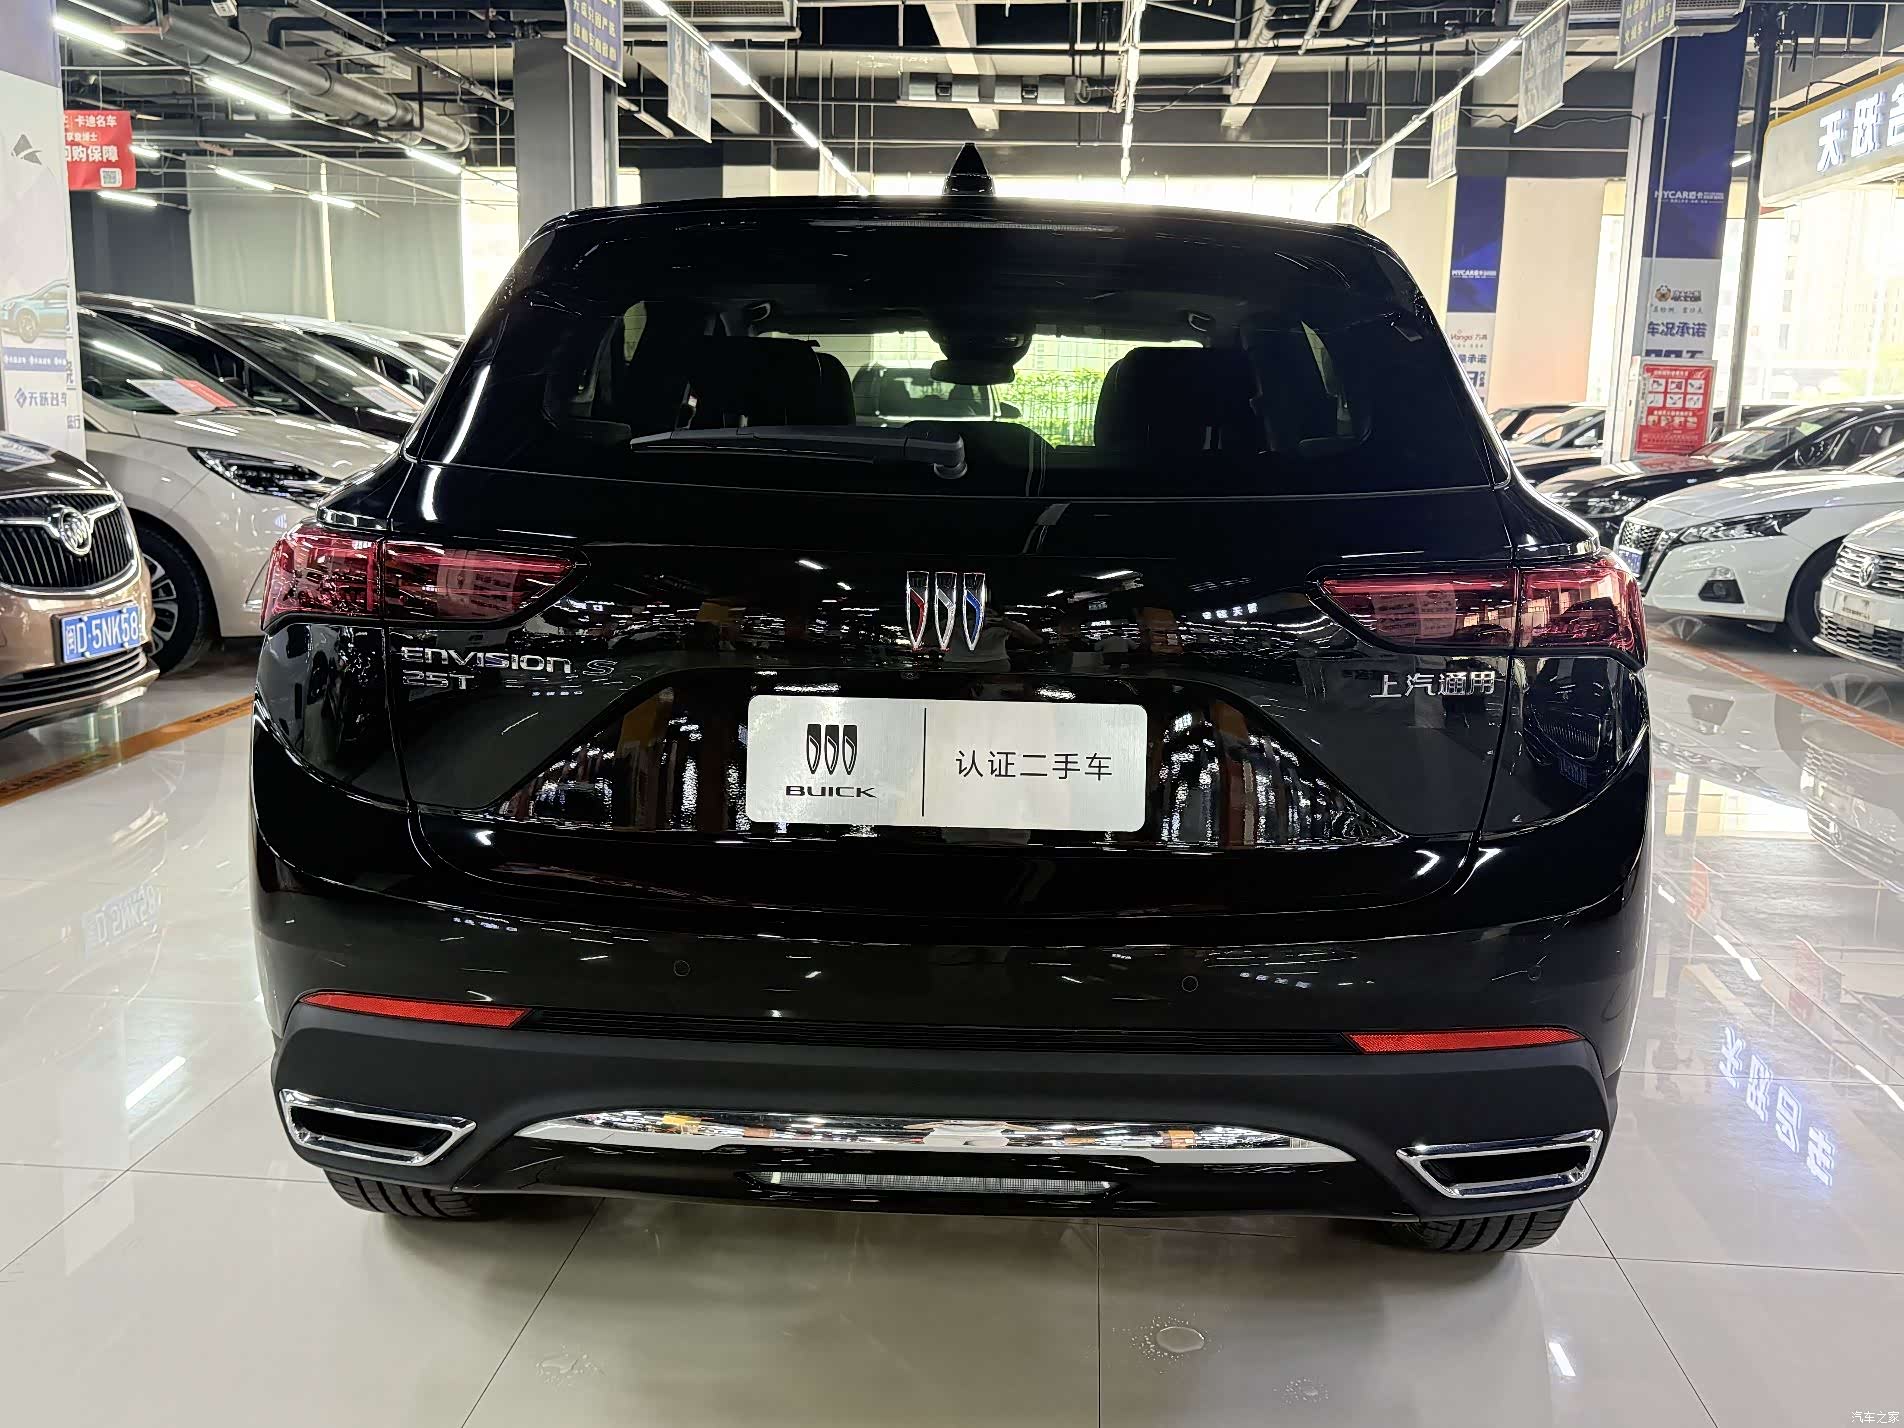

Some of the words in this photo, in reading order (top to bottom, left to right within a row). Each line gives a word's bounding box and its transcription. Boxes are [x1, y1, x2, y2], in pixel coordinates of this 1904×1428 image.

[75, 115, 117, 128] 卡迪名车
[1648, 321, 1708, 338] 车况承诺
[583, 659, 618, 676] S
[402, 669, 475, 690] 25T
[1370, 671, 1496, 697] 上汽通用
[955, 750, 1113, 781] 认证二手车
[785, 785, 877, 798] BUICK
